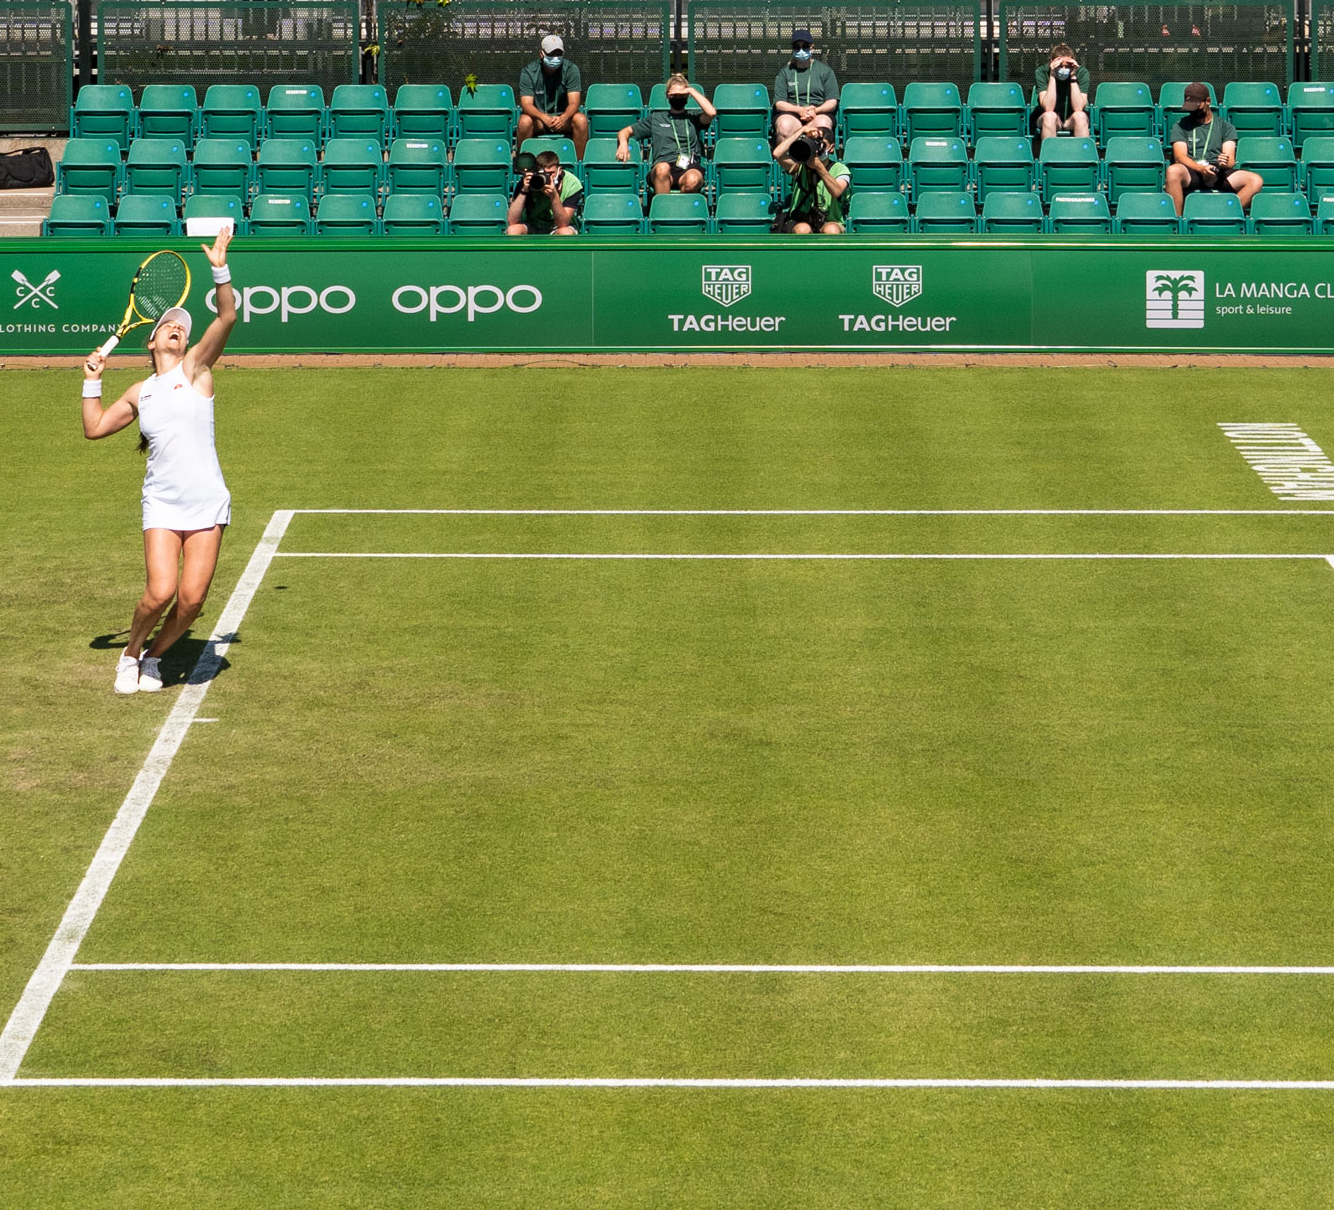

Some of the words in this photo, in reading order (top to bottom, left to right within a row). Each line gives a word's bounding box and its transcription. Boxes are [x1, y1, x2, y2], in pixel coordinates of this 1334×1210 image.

[706, 268, 747, 281] TAG
[877, 268, 918, 281] TAG
[705, 284, 748, 304] HEUER
[876, 284, 919, 304] HEUER
[1215, 283, 1236, 298] LA
[1240, 283, 1310, 298] MANGA
[391, 284, 543, 322] oppo
[1215, 305, 1243, 317] sport
[1246, 305, 1254, 314] &
[1257, 304, 1292, 315] leisure
